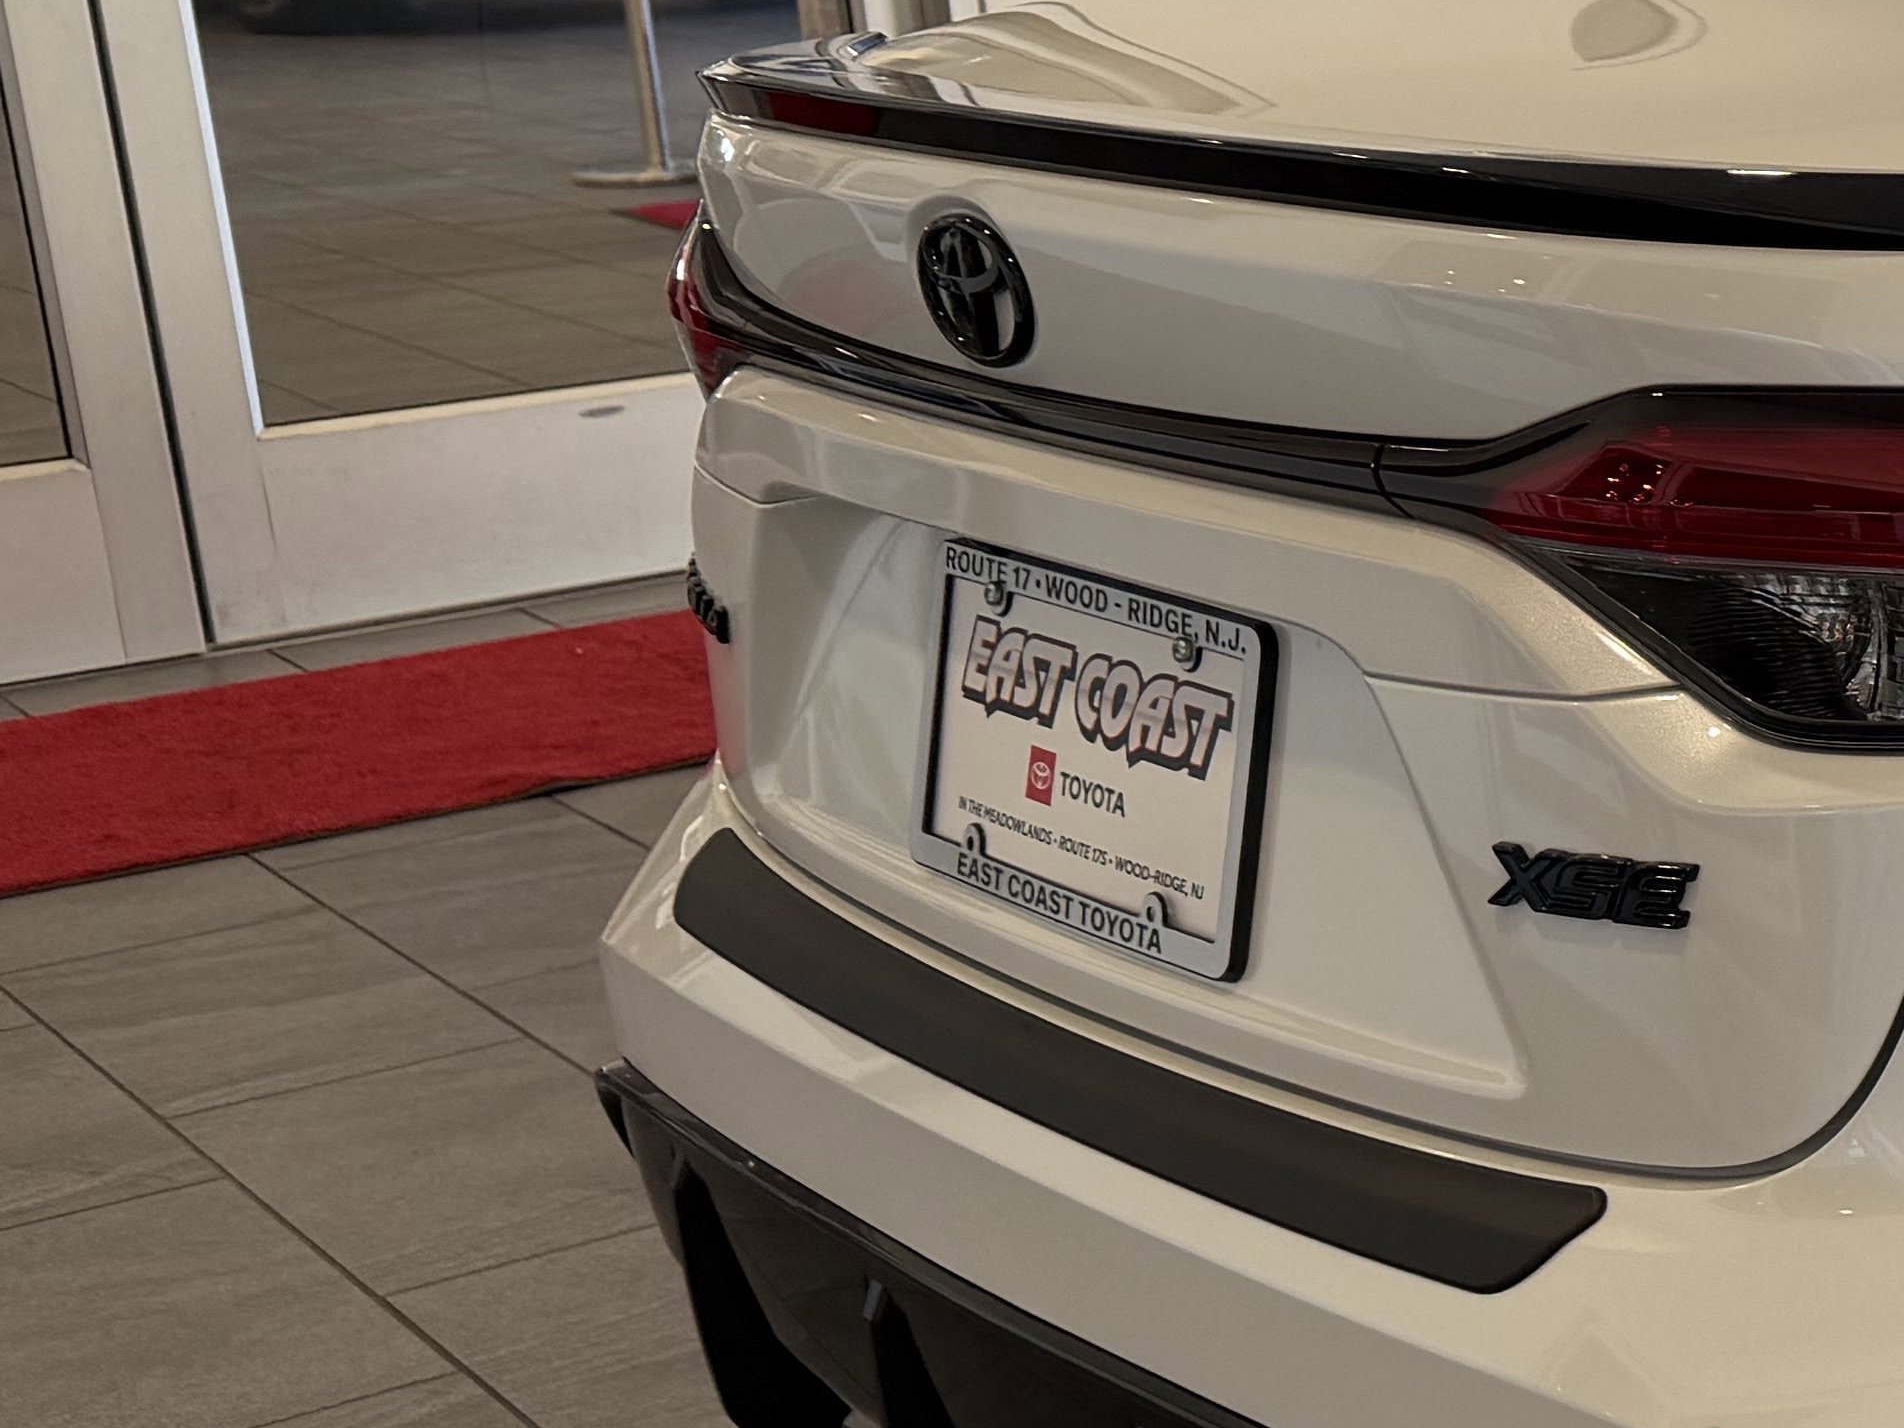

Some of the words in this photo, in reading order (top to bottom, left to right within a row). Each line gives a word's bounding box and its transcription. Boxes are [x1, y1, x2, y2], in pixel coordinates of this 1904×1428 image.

[945, 545, 1008, 583] ROUTE
[1012, 565, 1031, 592] 17
[1044, 573, 1108, 614] WOOD
[1127, 599, 1199, 642] RIDGE,
[1205, 621, 1248, 657] N.J.
[961, 614, 1079, 729] EAST
[1074, 652, 1236, 782] COAST
[1059, 770, 1127, 819] TOYOTA
[967, 798, 983, 820] THE
[983, 803, 1053, 846] MEADOWLANDS
[1057, 834, 1092, 863] ROUTE
[1113, 855, 1190, 900] WOOD-RIDGE,
[1191, 881, 1206, 902] NJ
[1487, 840, 1700, 929] XSE
[956, 851, 1004, 890] EAST
[1008, 871, 1074, 921] COAST
[1078, 896, 1162, 956] TOYOTA
